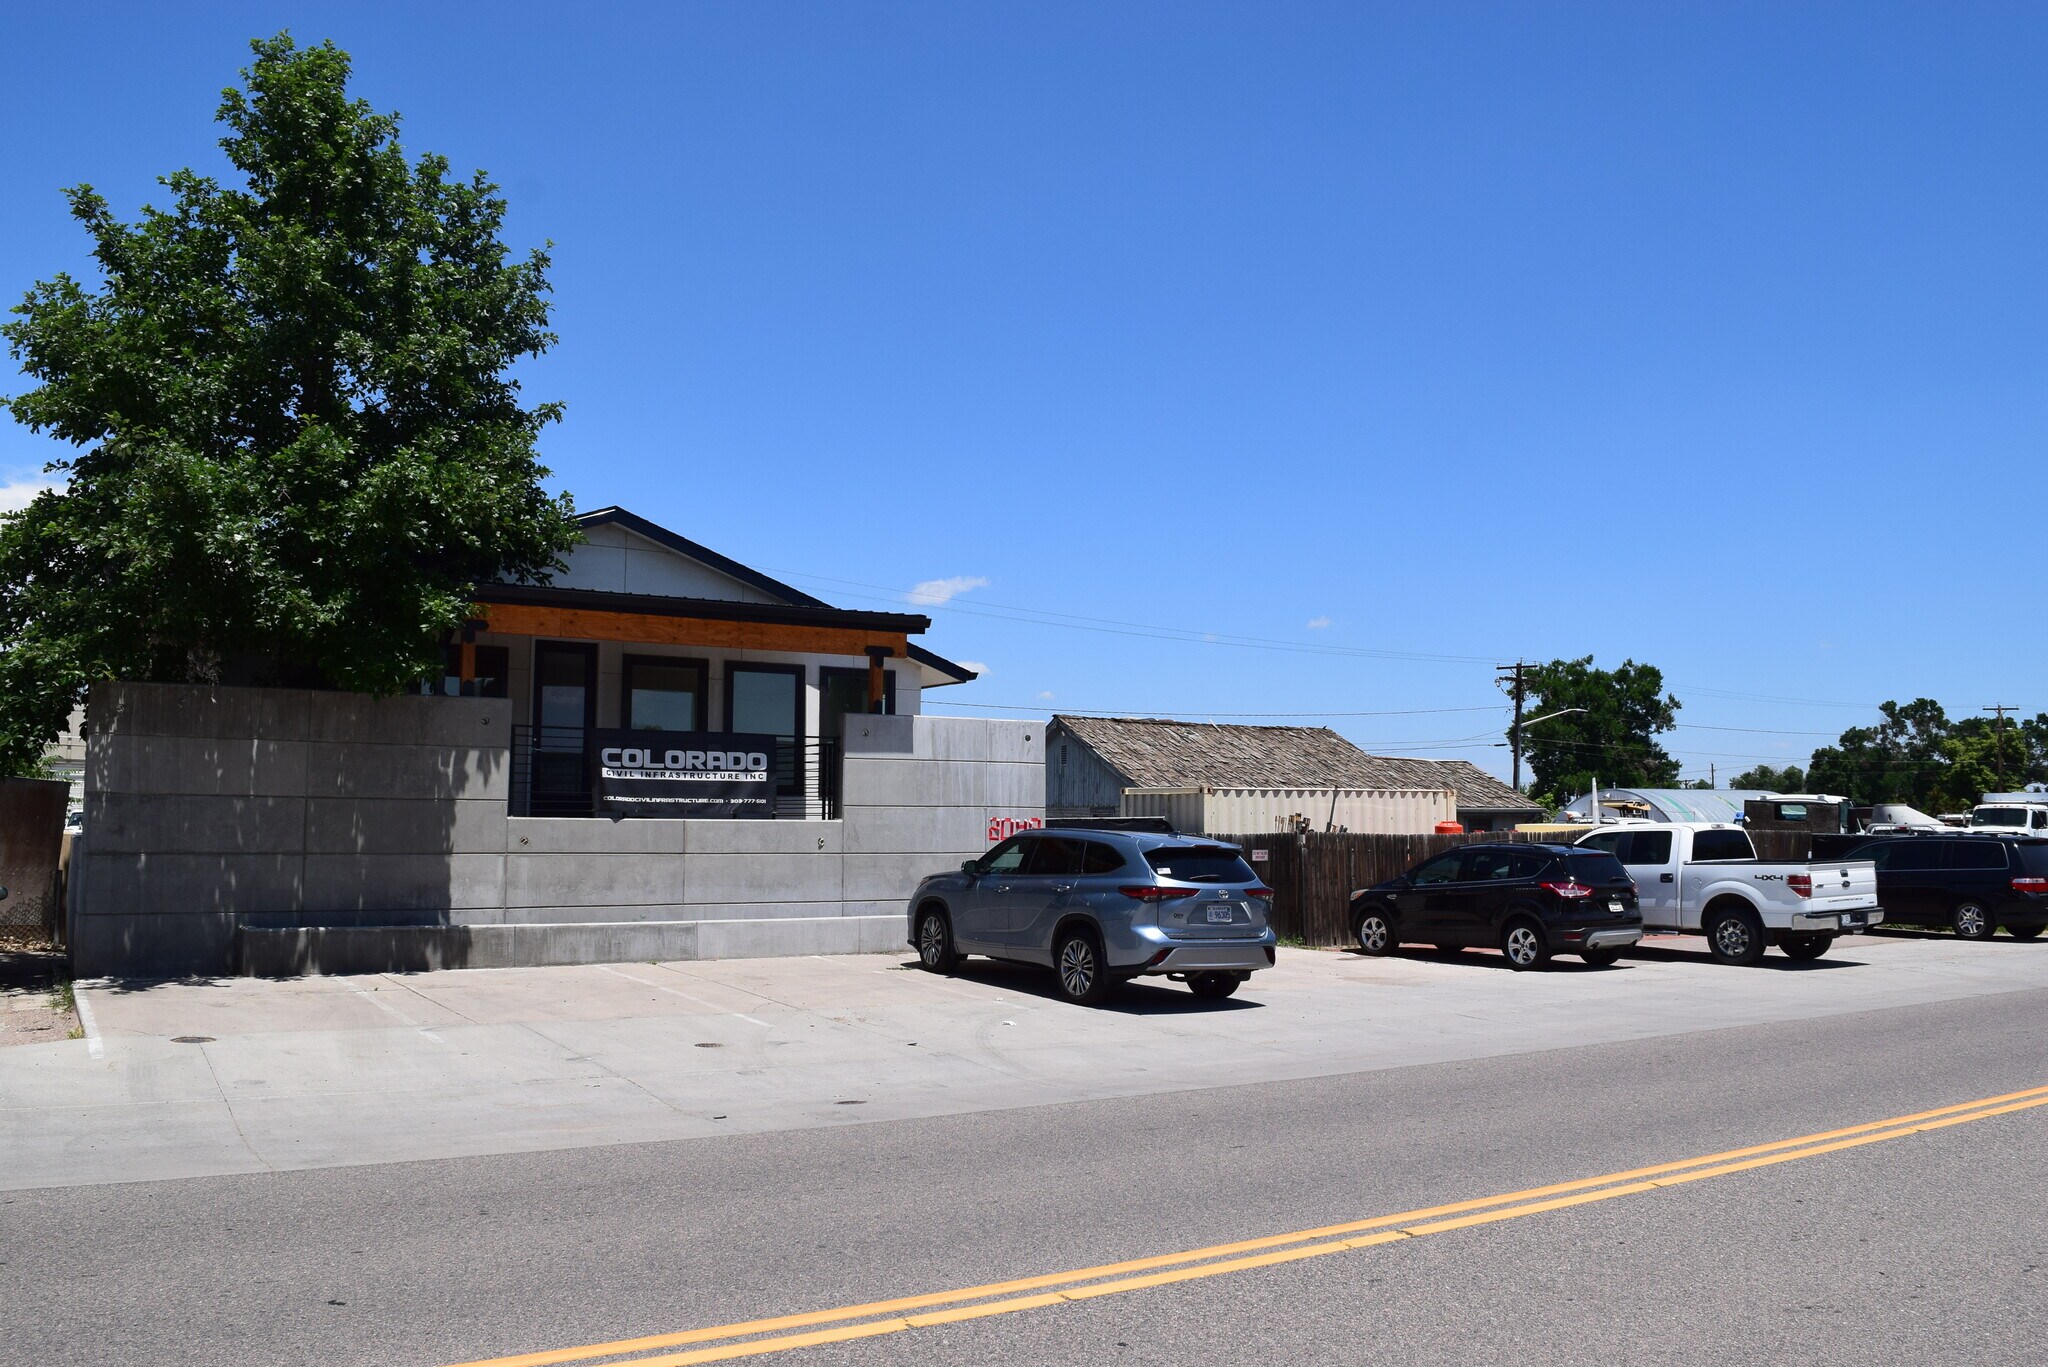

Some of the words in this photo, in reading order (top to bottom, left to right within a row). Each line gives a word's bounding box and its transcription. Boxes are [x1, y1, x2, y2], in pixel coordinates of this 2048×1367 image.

[601, 748, 768, 771] COLORADO
[605, 769, 635, 778] CIVIL
[640, 771, 740, 780] INFRASTRUCTURE
